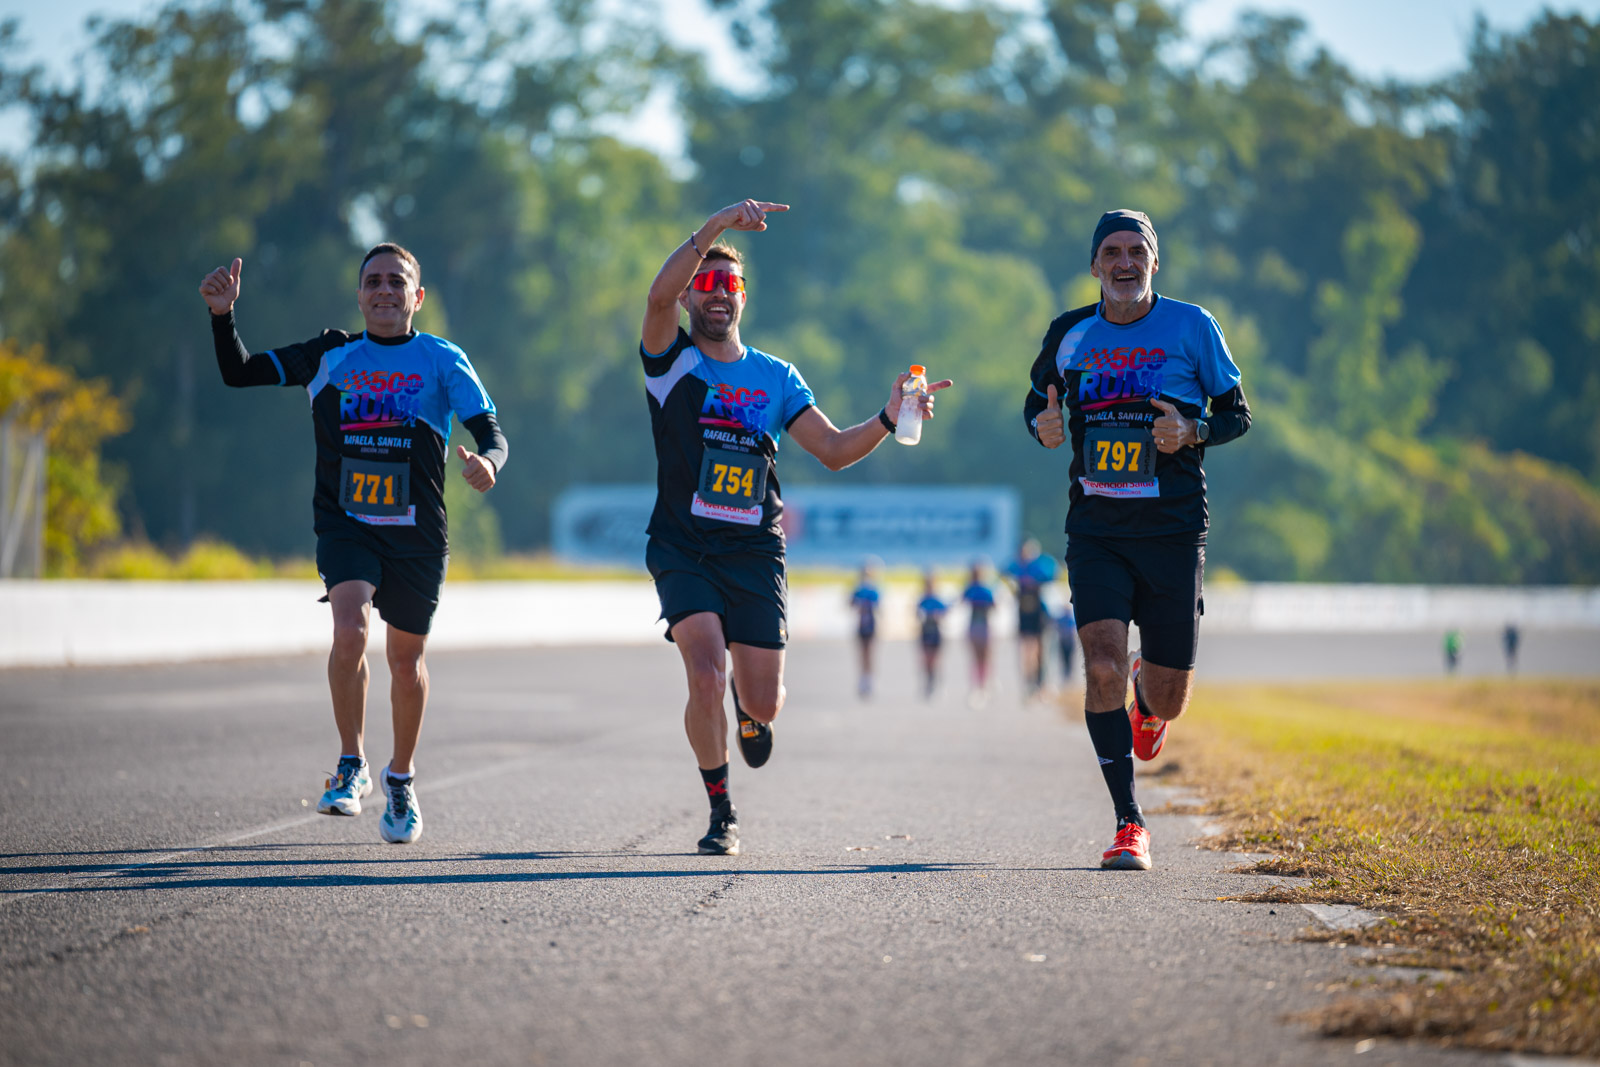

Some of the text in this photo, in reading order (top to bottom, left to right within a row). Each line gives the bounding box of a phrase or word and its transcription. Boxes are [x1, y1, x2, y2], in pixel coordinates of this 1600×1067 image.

[1118, 411, 1143, 421] SANTA
[1144, 413, 1154, 422] FE
[344, 434, 412, 449] RAFAELA, SANTA FE
[703, 429, 738, 444] RAFAELA,
[1096, 440, 1142, 472] 797
[353, 472, 395, 505] 771
[712, 463, 754, 497] 754
